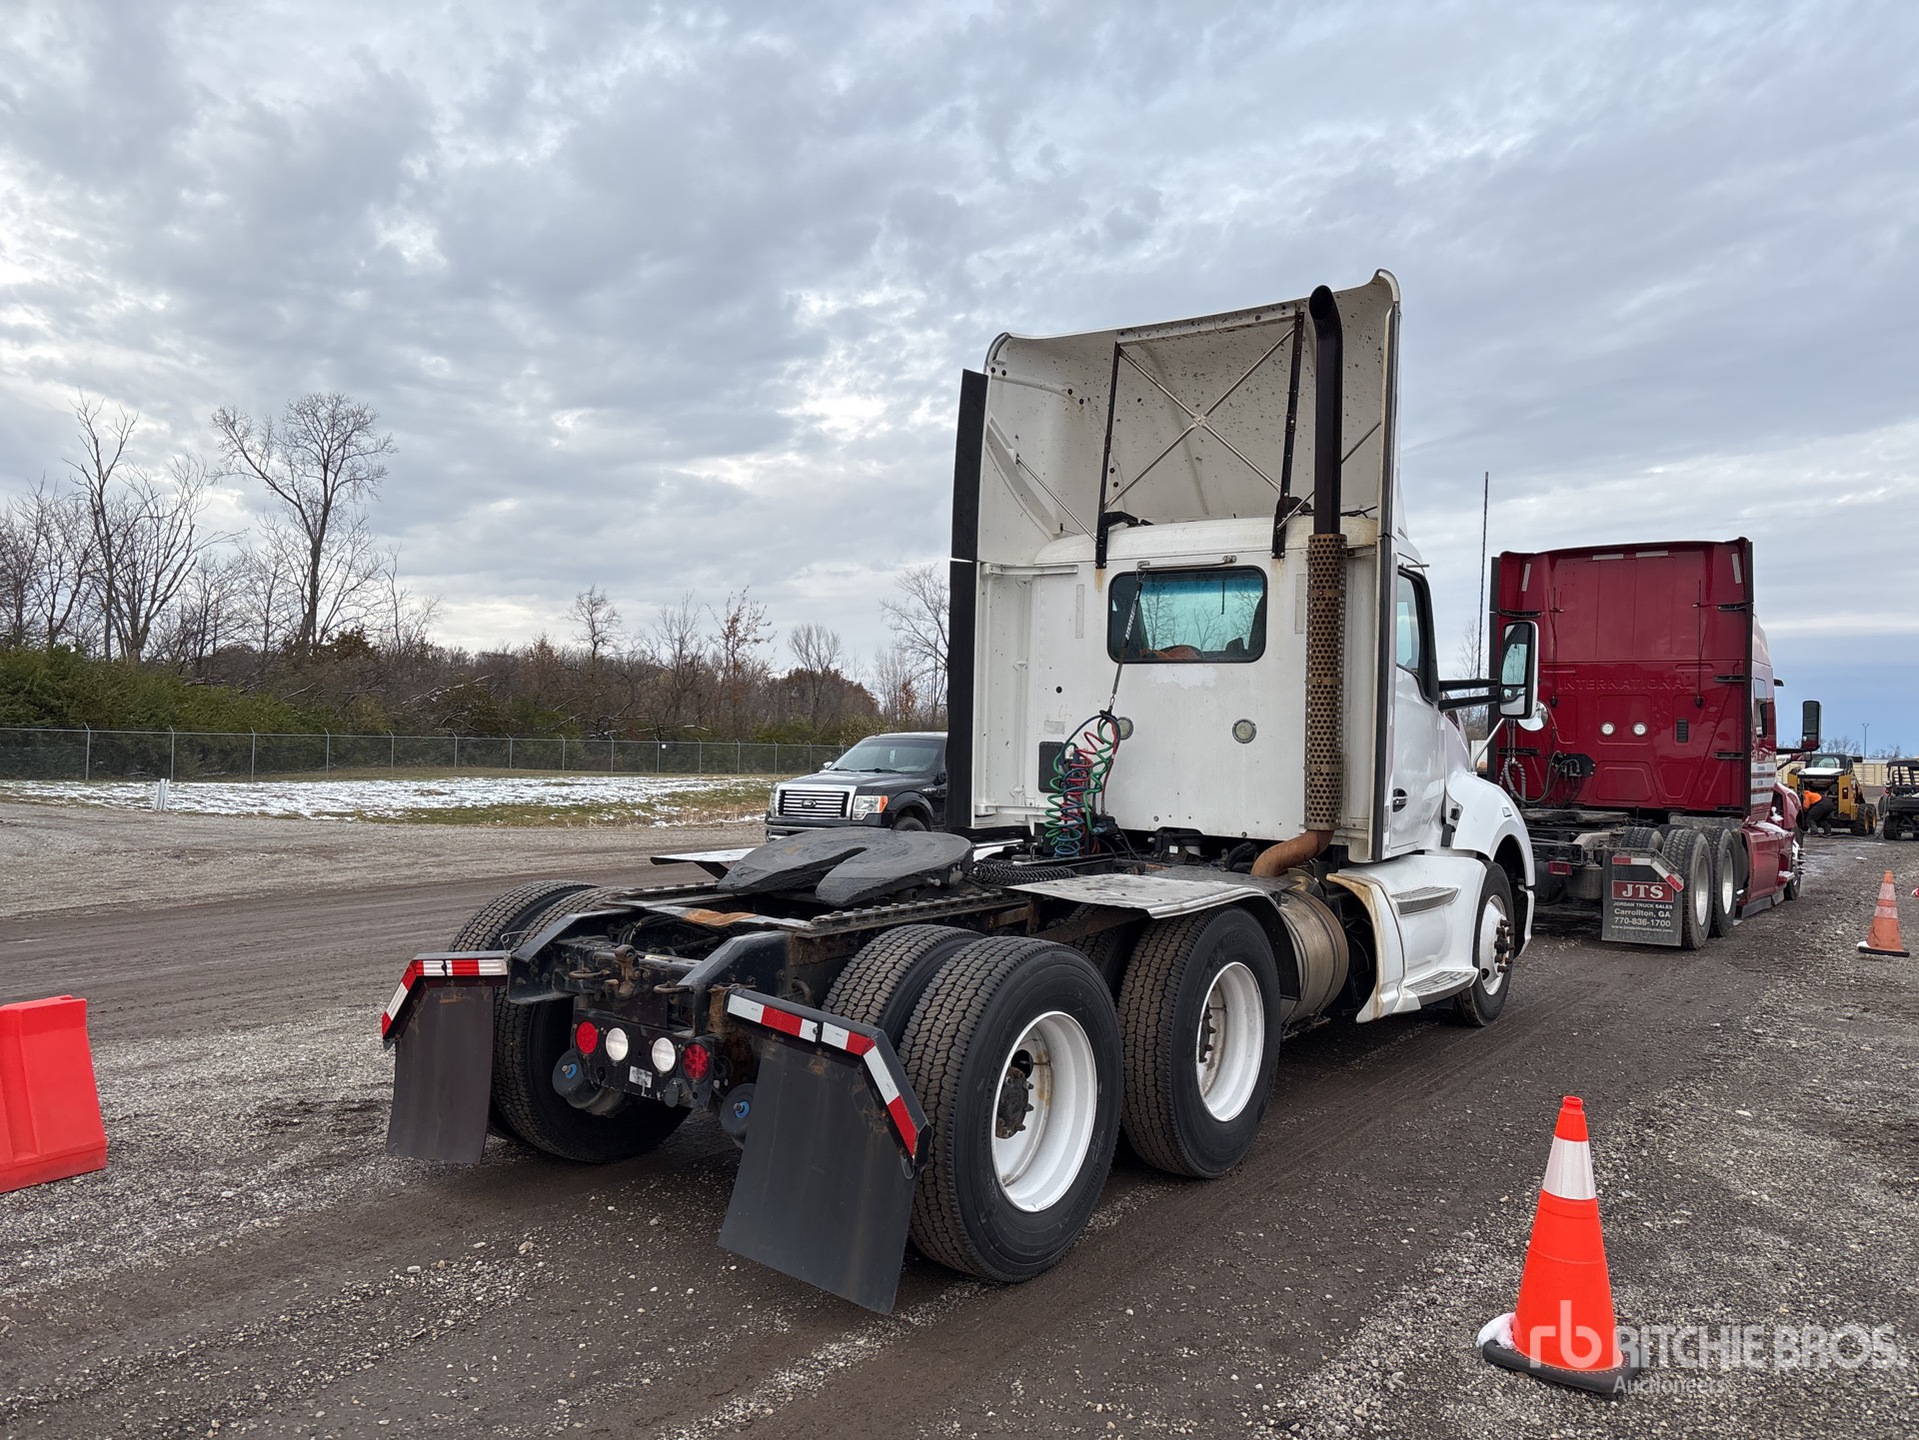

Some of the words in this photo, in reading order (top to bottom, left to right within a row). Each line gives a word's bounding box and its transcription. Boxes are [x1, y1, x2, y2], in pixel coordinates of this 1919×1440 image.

[1557, 678, 1695, 690] INTERNATIONAL
[1621, 884, 1664, 899] JTS
[1614, 908, 1656, 918] Carrollton,
[1658, 910, 1671, 918] GA
[1614, 917, 1671, 927] 770-836-1700
